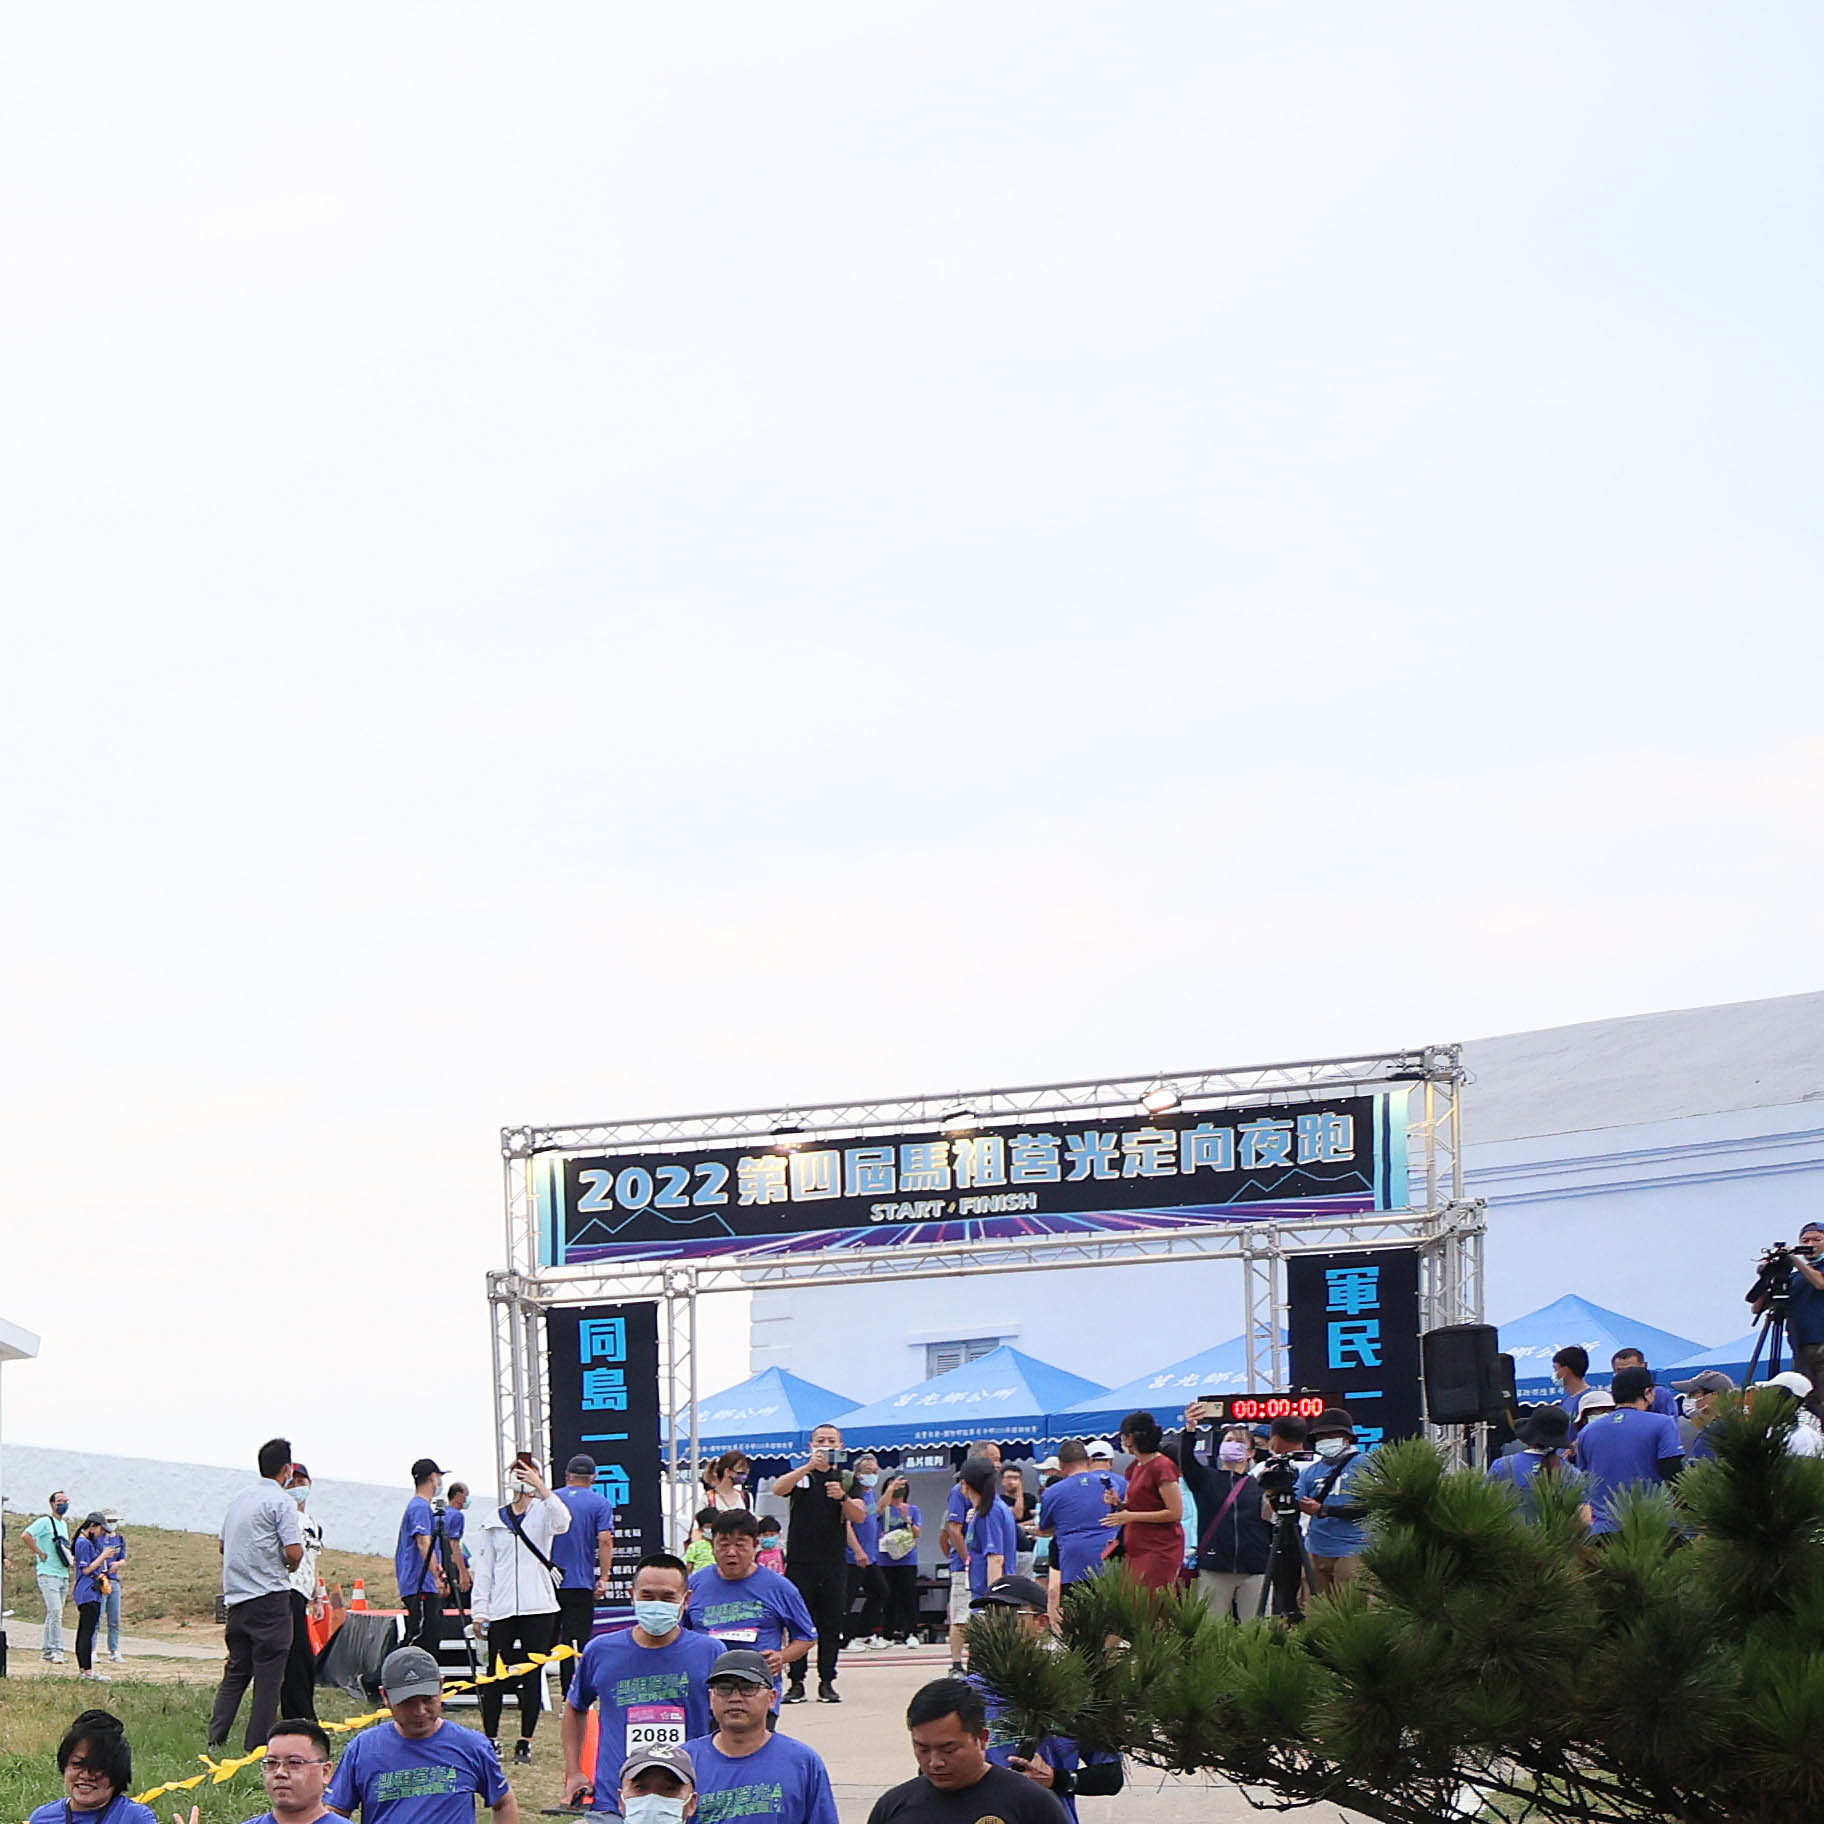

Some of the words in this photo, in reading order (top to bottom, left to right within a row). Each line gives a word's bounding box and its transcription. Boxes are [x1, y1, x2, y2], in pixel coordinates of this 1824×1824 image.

[870, 1200, 945, 1221] START
[958, 1192, 1037, 1215] FINISH
[1231, 1397, 1324, 1418] 00:00:00
[632, 1728, 680, 1742] 2088
